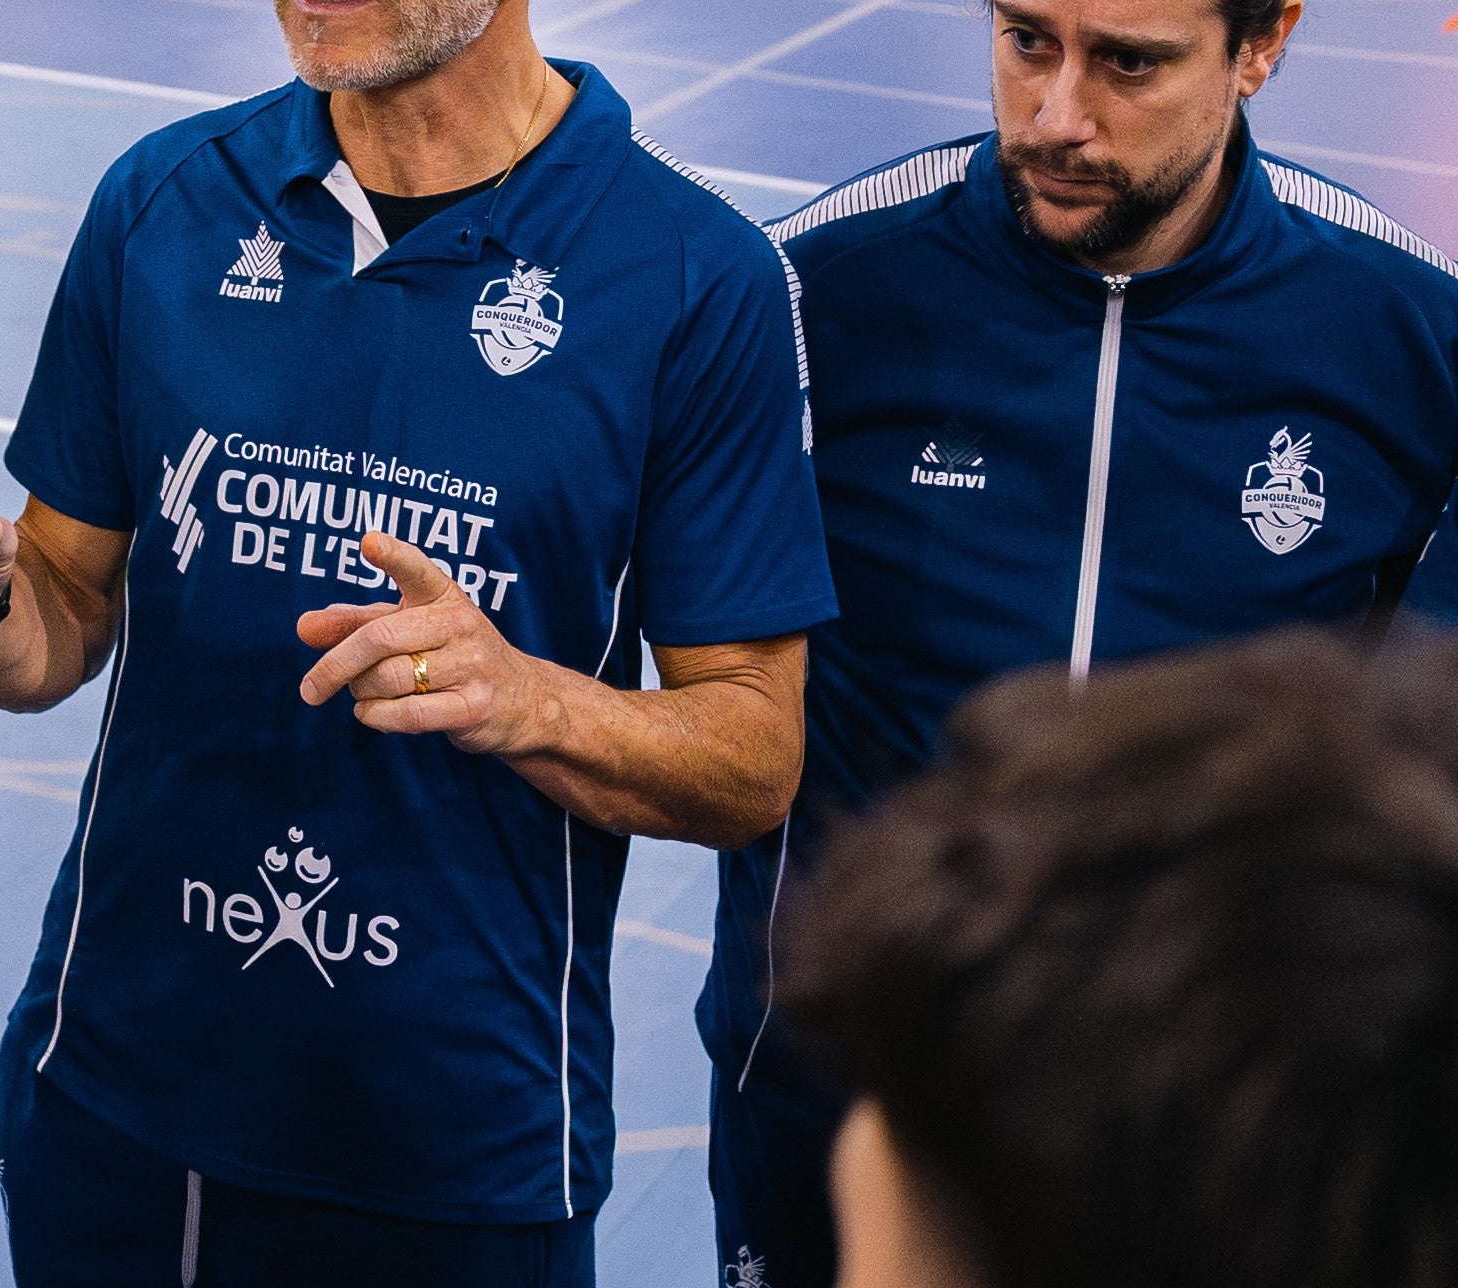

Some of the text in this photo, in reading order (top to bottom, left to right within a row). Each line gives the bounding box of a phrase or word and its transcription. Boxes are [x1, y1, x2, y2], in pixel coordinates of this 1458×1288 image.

[219, 278, 283, 303] luanvi
[477, 310, 558, 337] CONQUERIDOR
[499, 322, 532, 334] VALENCIA
[224, 433, 498, 506] Comunitat Valenciana
[911, 465, 985, 489] luanvi
[217, 469, 494, 557] COMUNITAT
[1246, 493, 1323, 509] CONQUERIDOR
[1269, 503, 1301, 511] VALENCIA
[232, 521, 518, 611] DE L'ESRT
